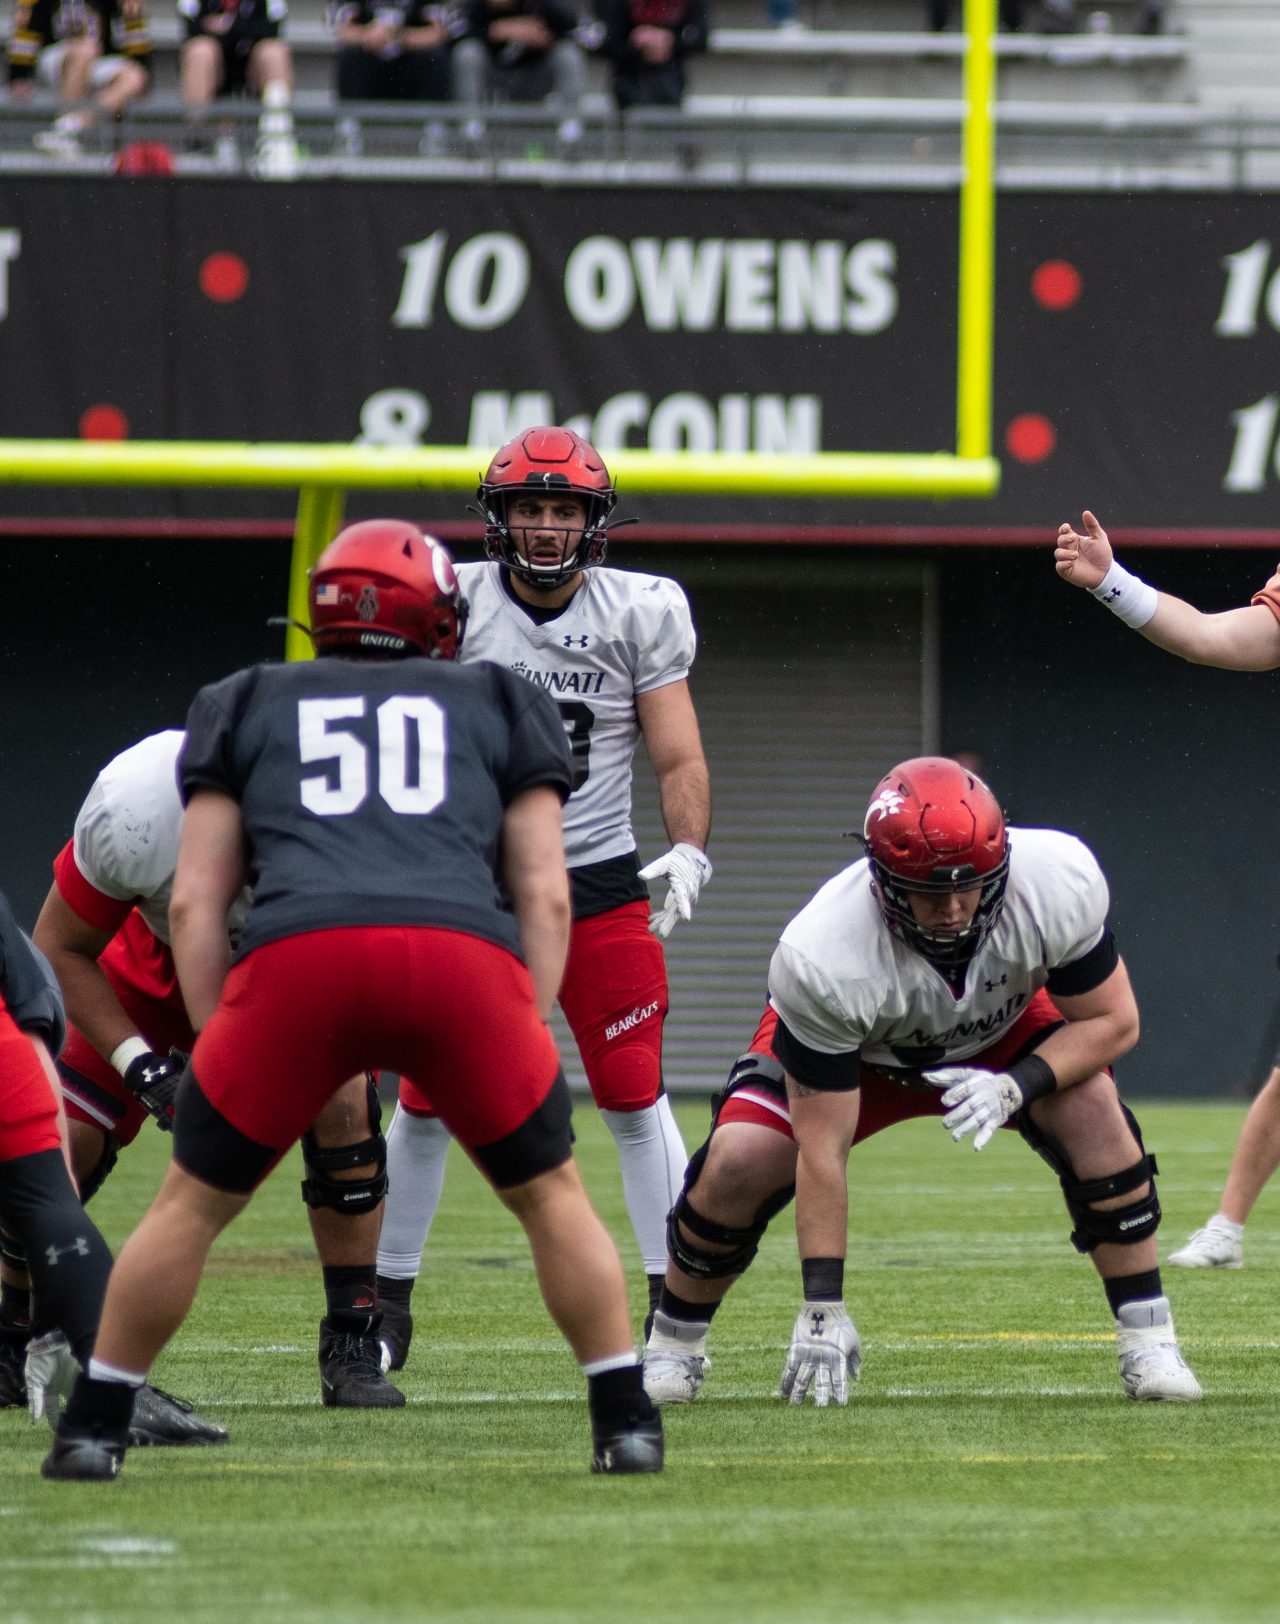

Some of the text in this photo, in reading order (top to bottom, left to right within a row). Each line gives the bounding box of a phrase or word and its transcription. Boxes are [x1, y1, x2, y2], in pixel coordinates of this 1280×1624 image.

[394, 231, 899, 334] 10 OWENS
[361, 633, 405, 648] UNITED
[512, 662, 604, 693] INNATI
[298, 696, 445, 815] 50
[605, 1001, 658, 1040] BEARCATS
